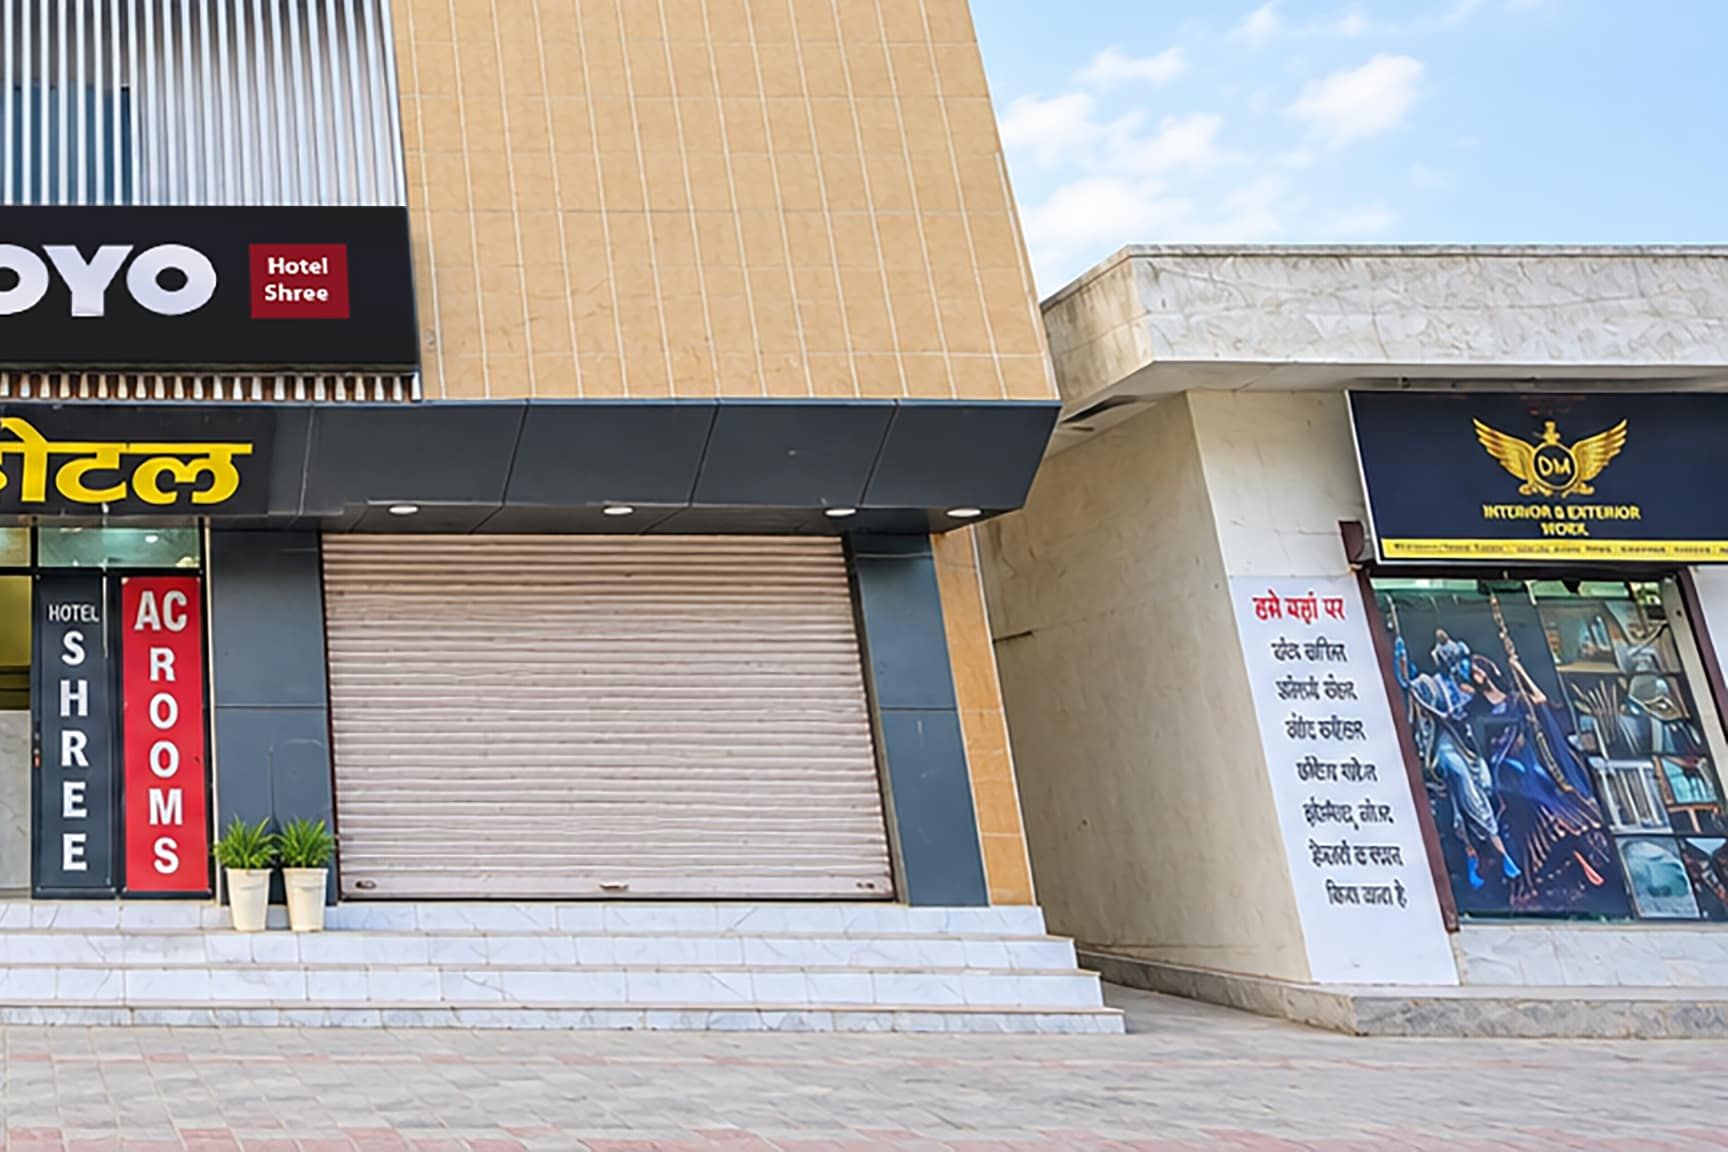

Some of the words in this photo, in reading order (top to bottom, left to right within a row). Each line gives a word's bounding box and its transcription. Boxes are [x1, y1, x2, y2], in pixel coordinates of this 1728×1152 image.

[268, 257, 328, 276] Hotel
[264, 284, 329, 303] Shree
[48, 603, 100, 624] HOTEL
[134, 589, 188, 632] AC
[58, 630, 90, 872] SHREE
[148, 646, 184, 875] ROOMS
